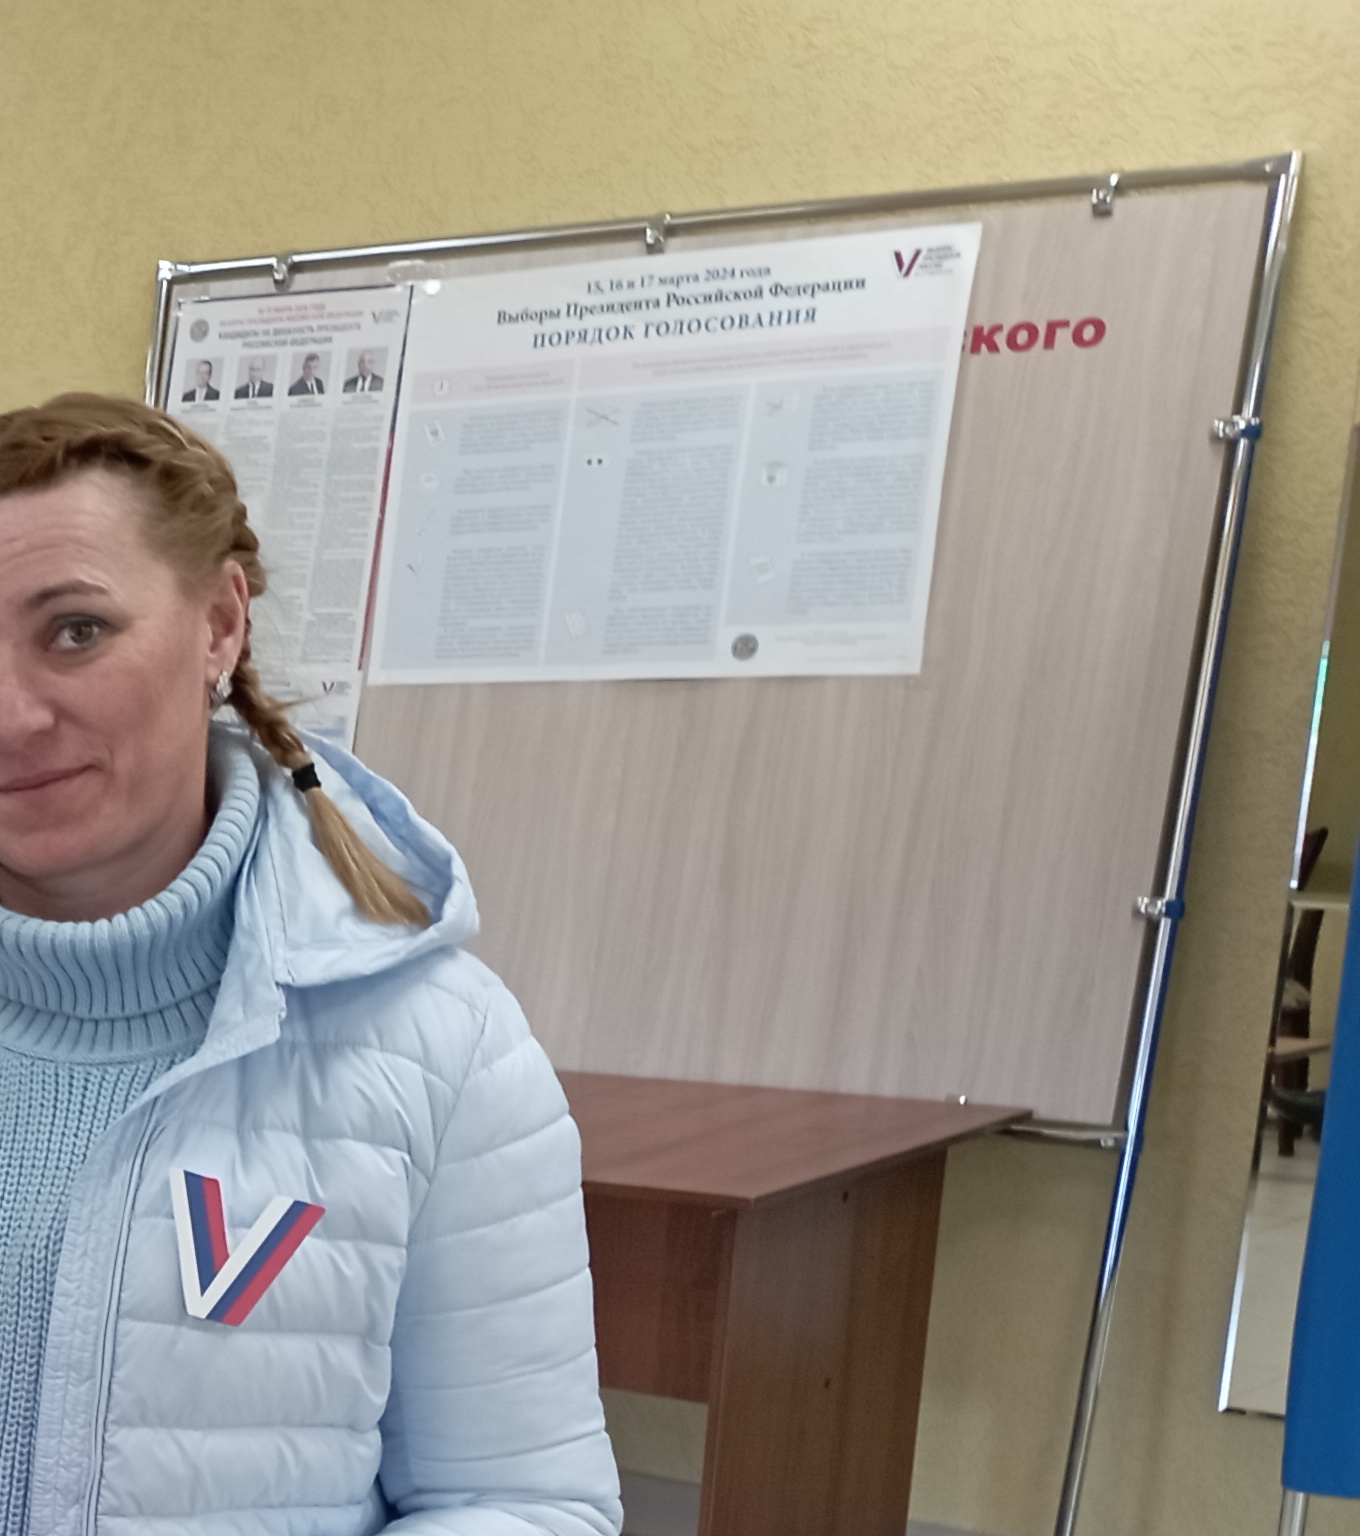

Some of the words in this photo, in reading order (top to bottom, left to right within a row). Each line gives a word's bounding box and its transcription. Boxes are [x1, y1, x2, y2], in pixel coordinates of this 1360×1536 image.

[640, 275, 655, 289] 17
[658, 273, 700, 288] марта
[704, 267, 735, 282] 2024
[739, 266, 771, 278] года
[497, 308, 562, 325] Выборы
[566, 297, 661, 321] Президента
[666, 285, 764, 309] Российской
[768, 277, 867, 299] Федерации
[533, 325, 635, 349] ПОРЯДОК
[644, 307, 818, 338] ГОЛОСОВАНИЯ
[962, 316, 1107, 356] кого
